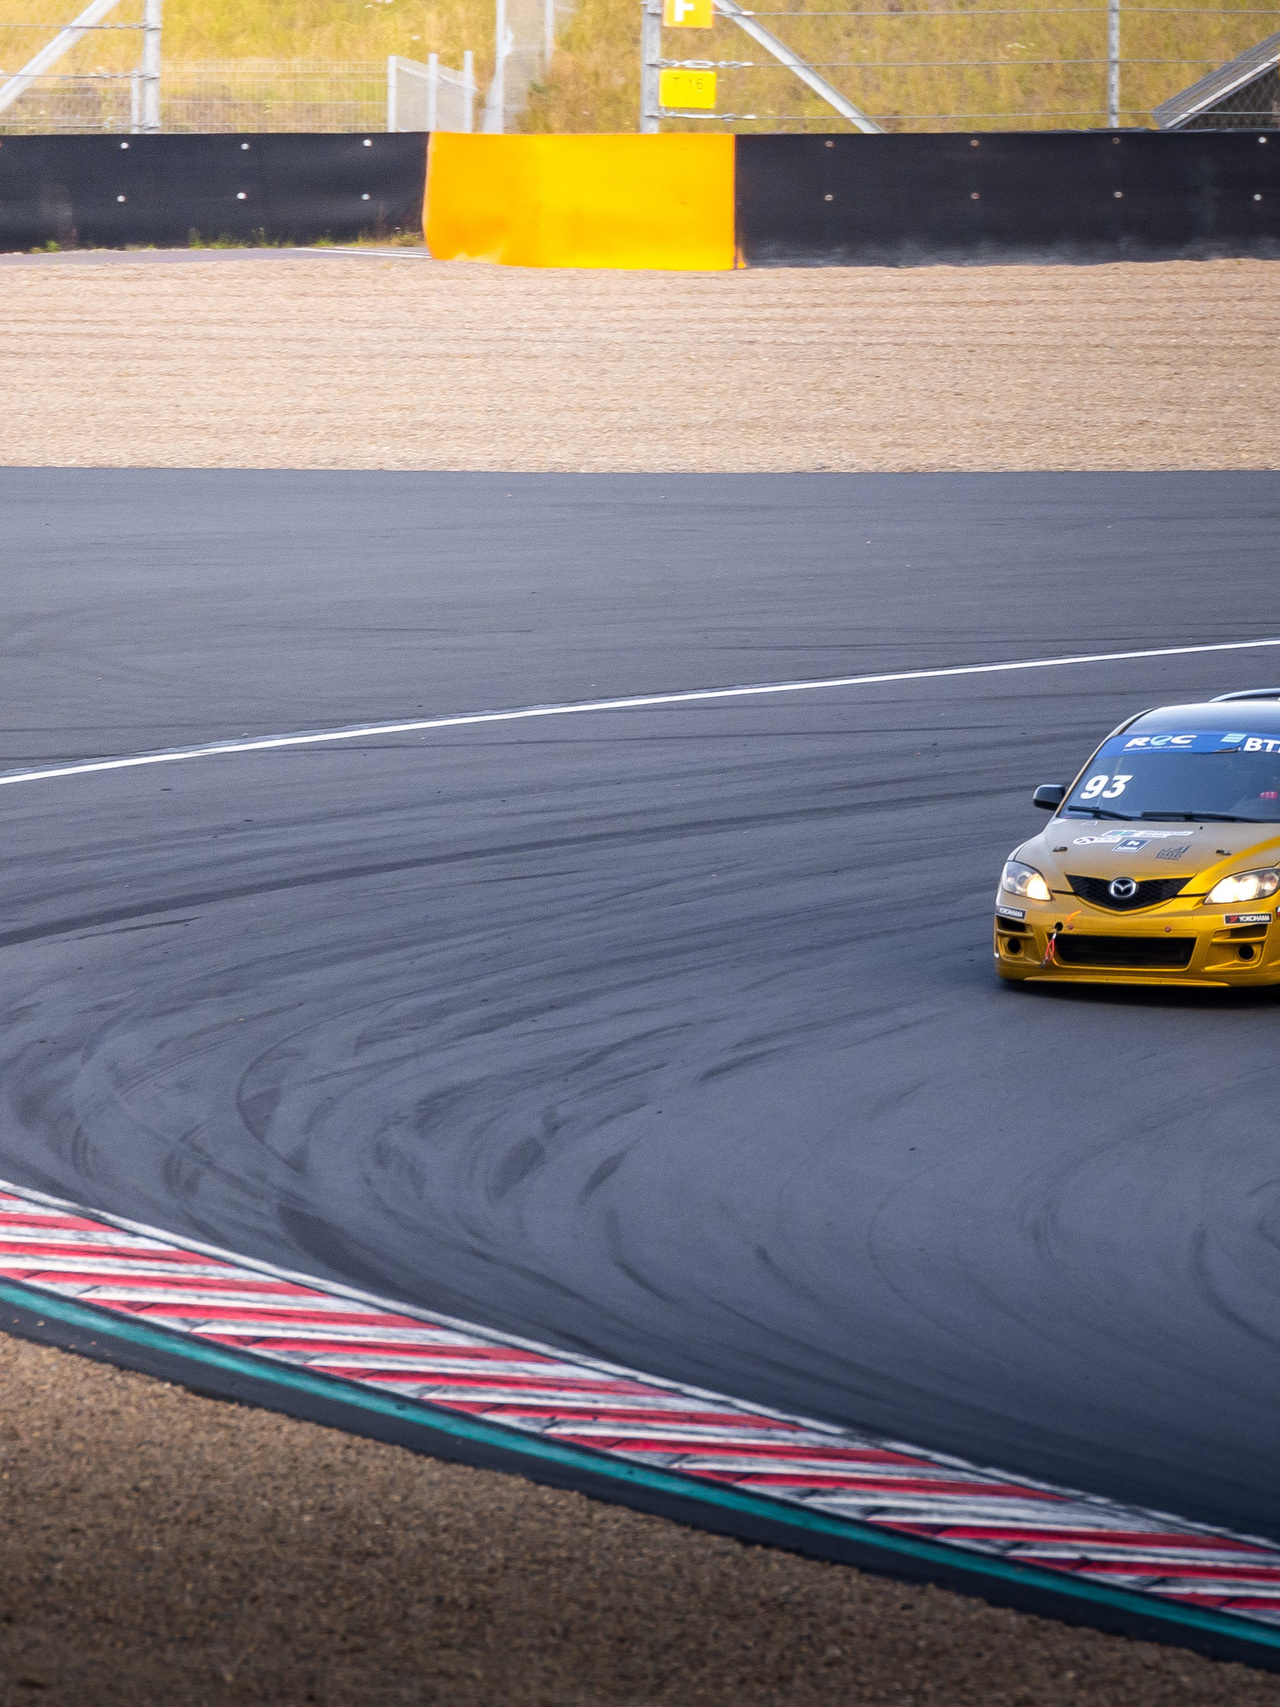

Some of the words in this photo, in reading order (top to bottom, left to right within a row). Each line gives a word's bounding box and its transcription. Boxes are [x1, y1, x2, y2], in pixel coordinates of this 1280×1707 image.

[687, 78, 704, 91] 16
[1080, 774, 1133, 800] 93
[1238, 914, 1271, 923] YOKOHAMA
